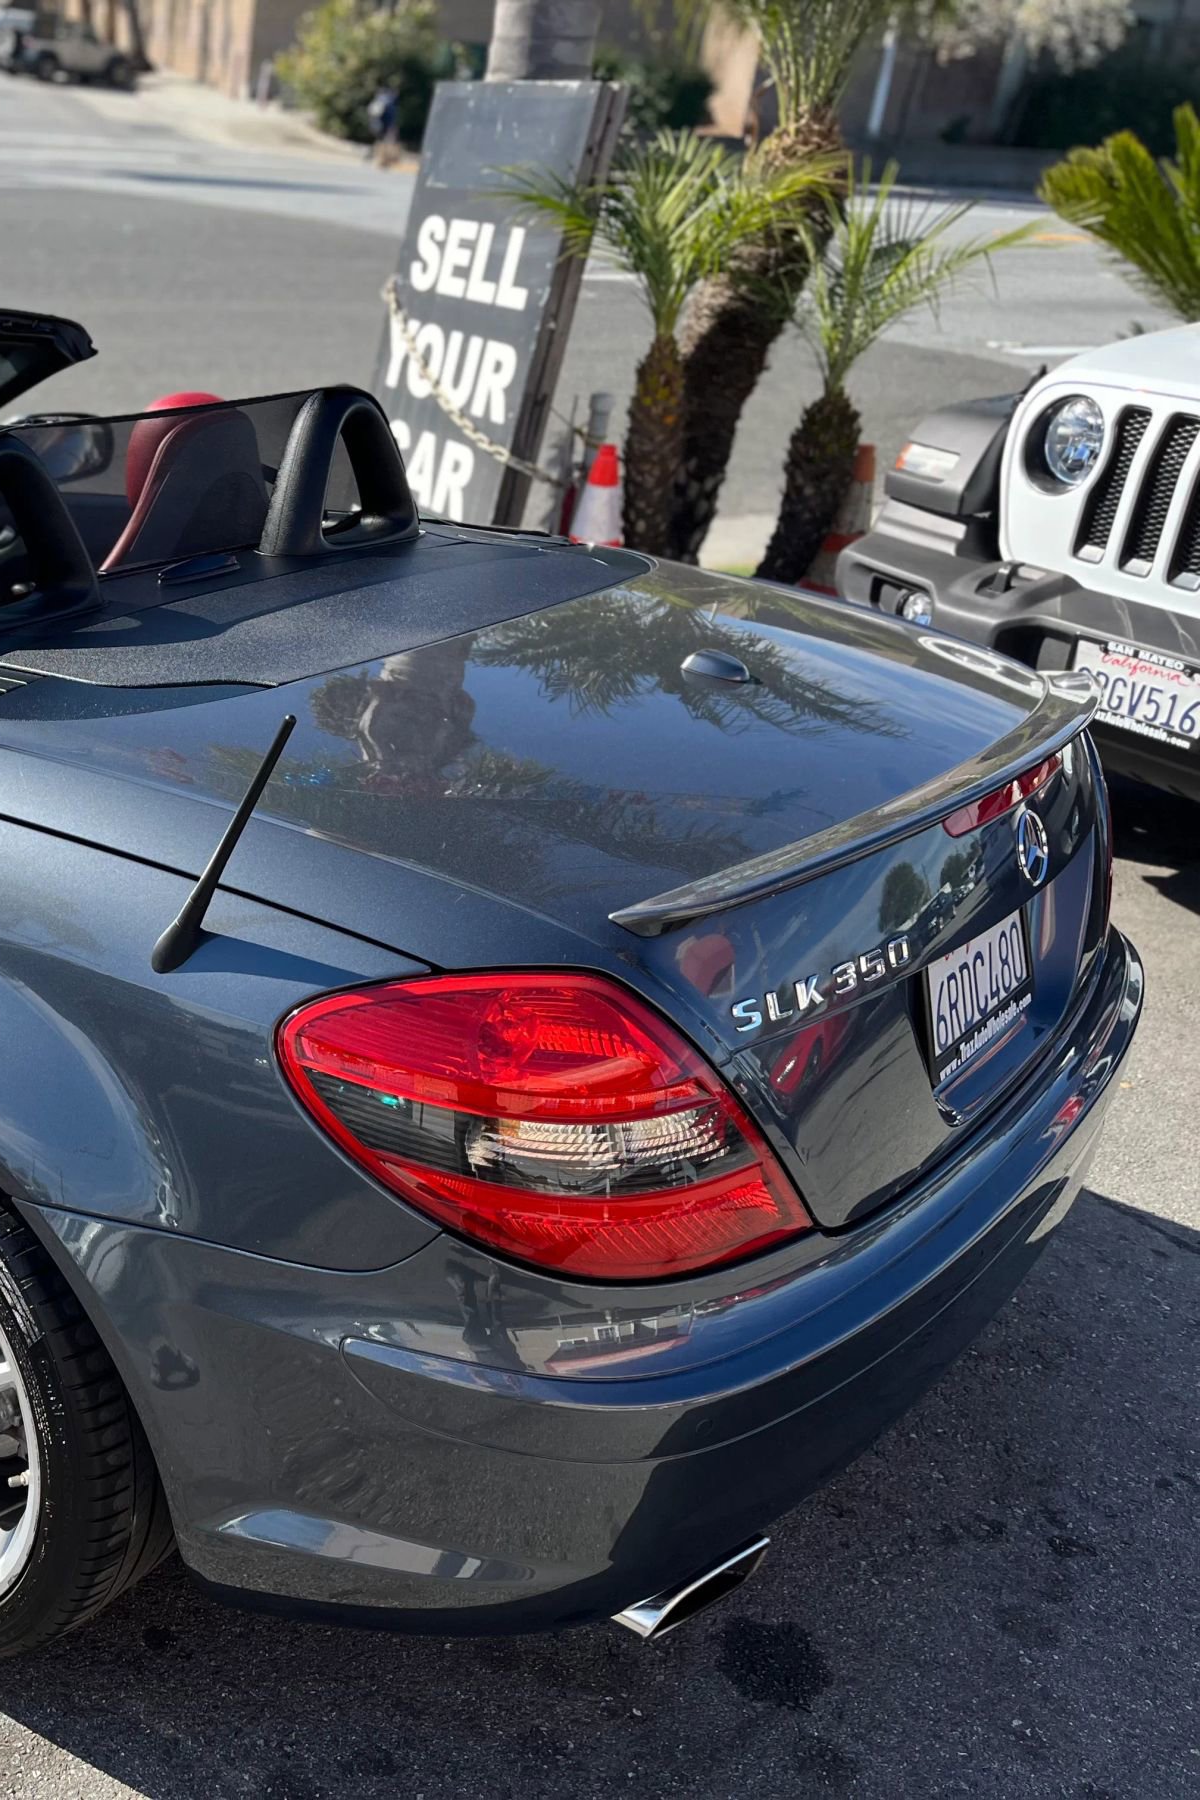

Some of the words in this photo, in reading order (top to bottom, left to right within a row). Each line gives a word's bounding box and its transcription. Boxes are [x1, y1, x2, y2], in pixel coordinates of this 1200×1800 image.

[409, 214, 528, 311] SELL
[385, 316, 517, 425] YOUR
[1107, 641, 1134, 656] SAN
[1138, 649, 1185, 671] MATEO
[731, 974, 824, 1033] SLK
[831, 935, 911, 995] 350
[936, 920, 1024, 1052] 6RDC480
